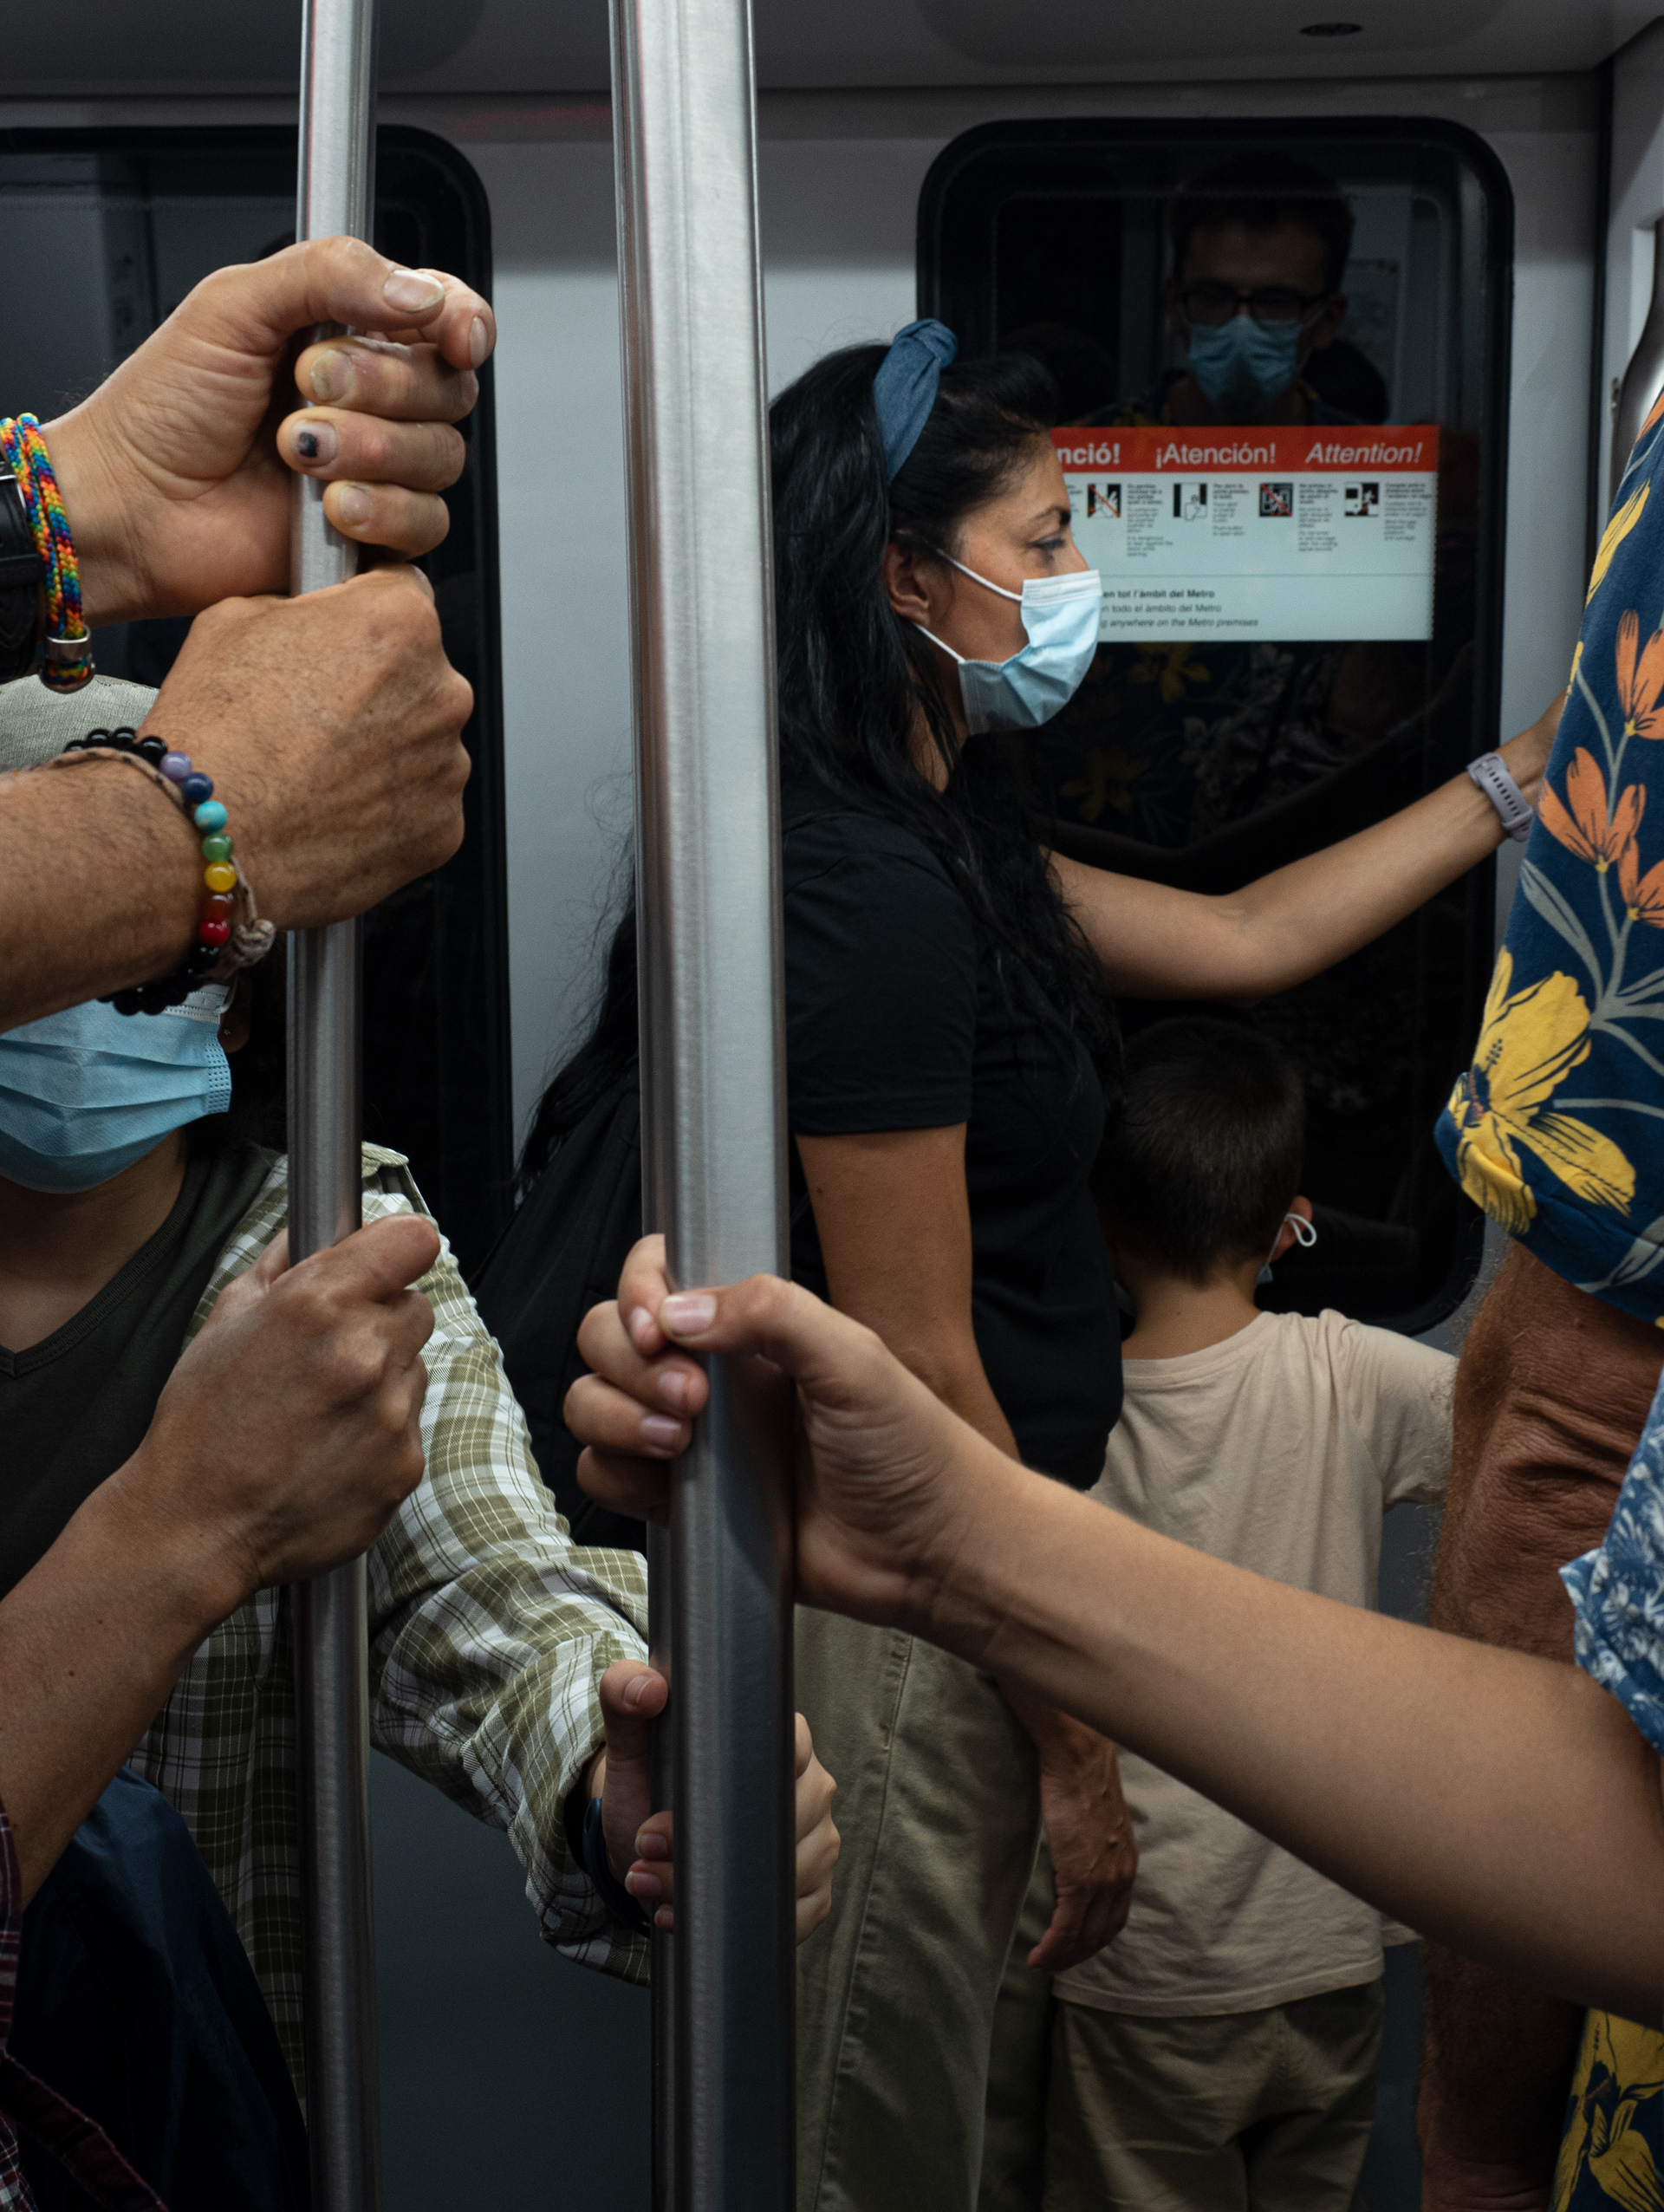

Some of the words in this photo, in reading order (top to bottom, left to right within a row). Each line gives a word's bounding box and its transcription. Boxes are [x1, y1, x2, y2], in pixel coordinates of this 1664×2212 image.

[1056, 442, 1121, 465] nció!
[1155, 442, 1276, 469] ¡Atención!
[1304, 441, 1423, 464] Attention!
[1186, 589, 1215, 598] Metro
[1194, 604, 1222, 613] Metro
[1110, 619, 1154, 628] anywhere
[1171, 618, 1186, 627] the
[1187, 618, 1215, 627] Metro
[1216, 619, 1259, 628] premises
